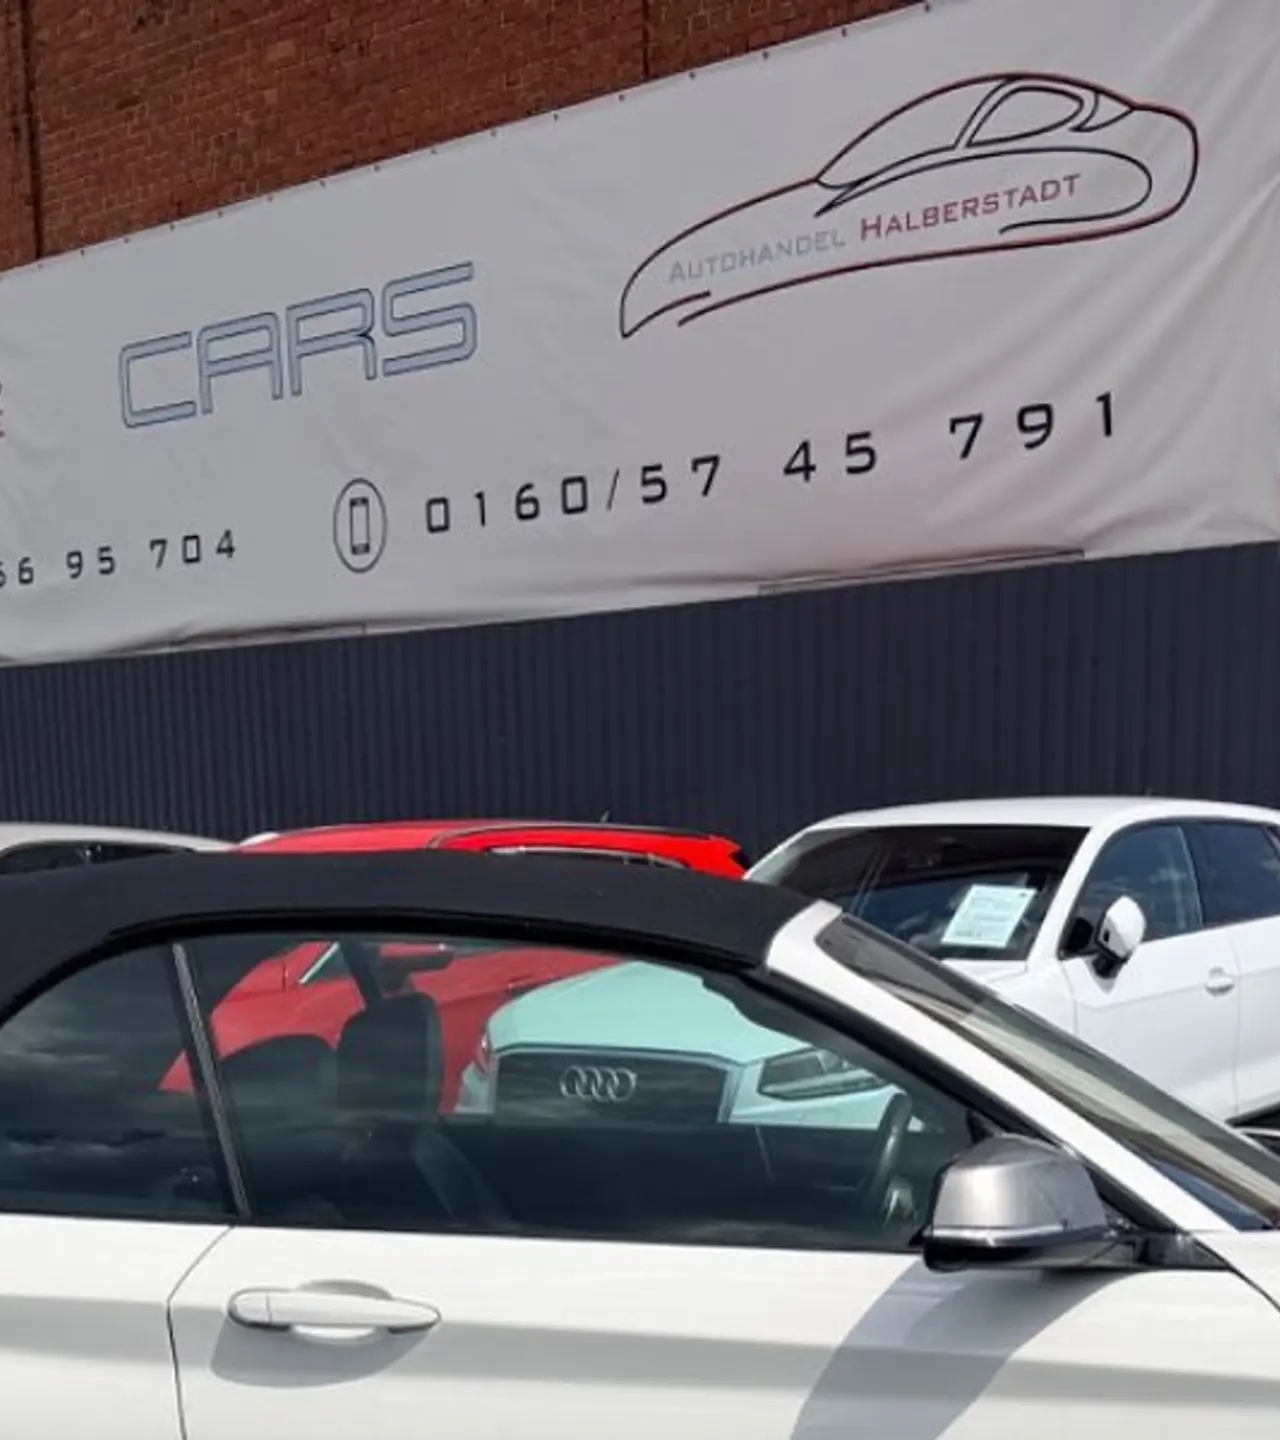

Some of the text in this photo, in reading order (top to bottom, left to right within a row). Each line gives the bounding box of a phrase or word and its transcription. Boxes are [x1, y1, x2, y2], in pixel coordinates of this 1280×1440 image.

[667, 173, 1082, 285] AUTOHANDEL HALBERSTADT
[120, 261, 478, 428] CARS
[425, 391, 1116, 535] 0160/57 45 791
[65, 545, 117, 580] 95
[149, 529, 237, 570] 704
